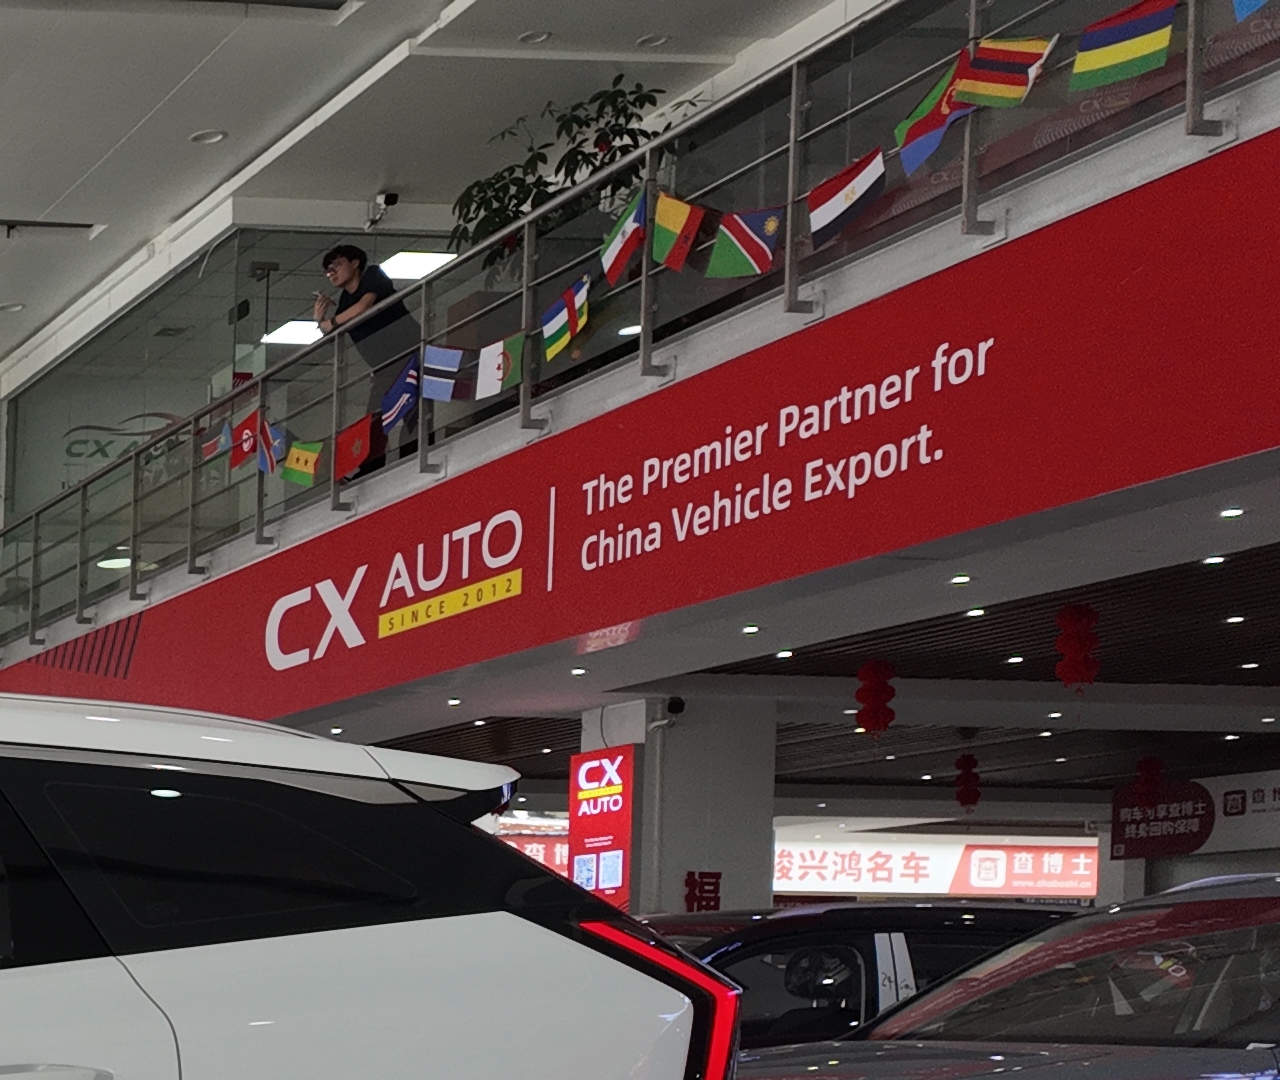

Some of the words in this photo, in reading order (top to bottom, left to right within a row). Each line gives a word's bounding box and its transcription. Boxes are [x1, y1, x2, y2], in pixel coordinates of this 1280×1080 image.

[582, 473, 633, 516] The
[642, 422, 769, 496] Premier
[778, 364, 921, 447] Partner
[930, 337, 995, 392] for
[581, 521, 662, 571] China
[671, 473, 792, 542] Vehicle
[803, 424, 944, 499] Export.
[265, 564, 369, 671] CX
[379, 509, 523, 608] AUTO
[388, 600, 446, 631] SINCE
[462, 578, 512, 607] 2012
[578, 756, 624, 790] CX
[578, 795, 623, 817] AUTO
[1012, 852, 1093, 875] 查博士
